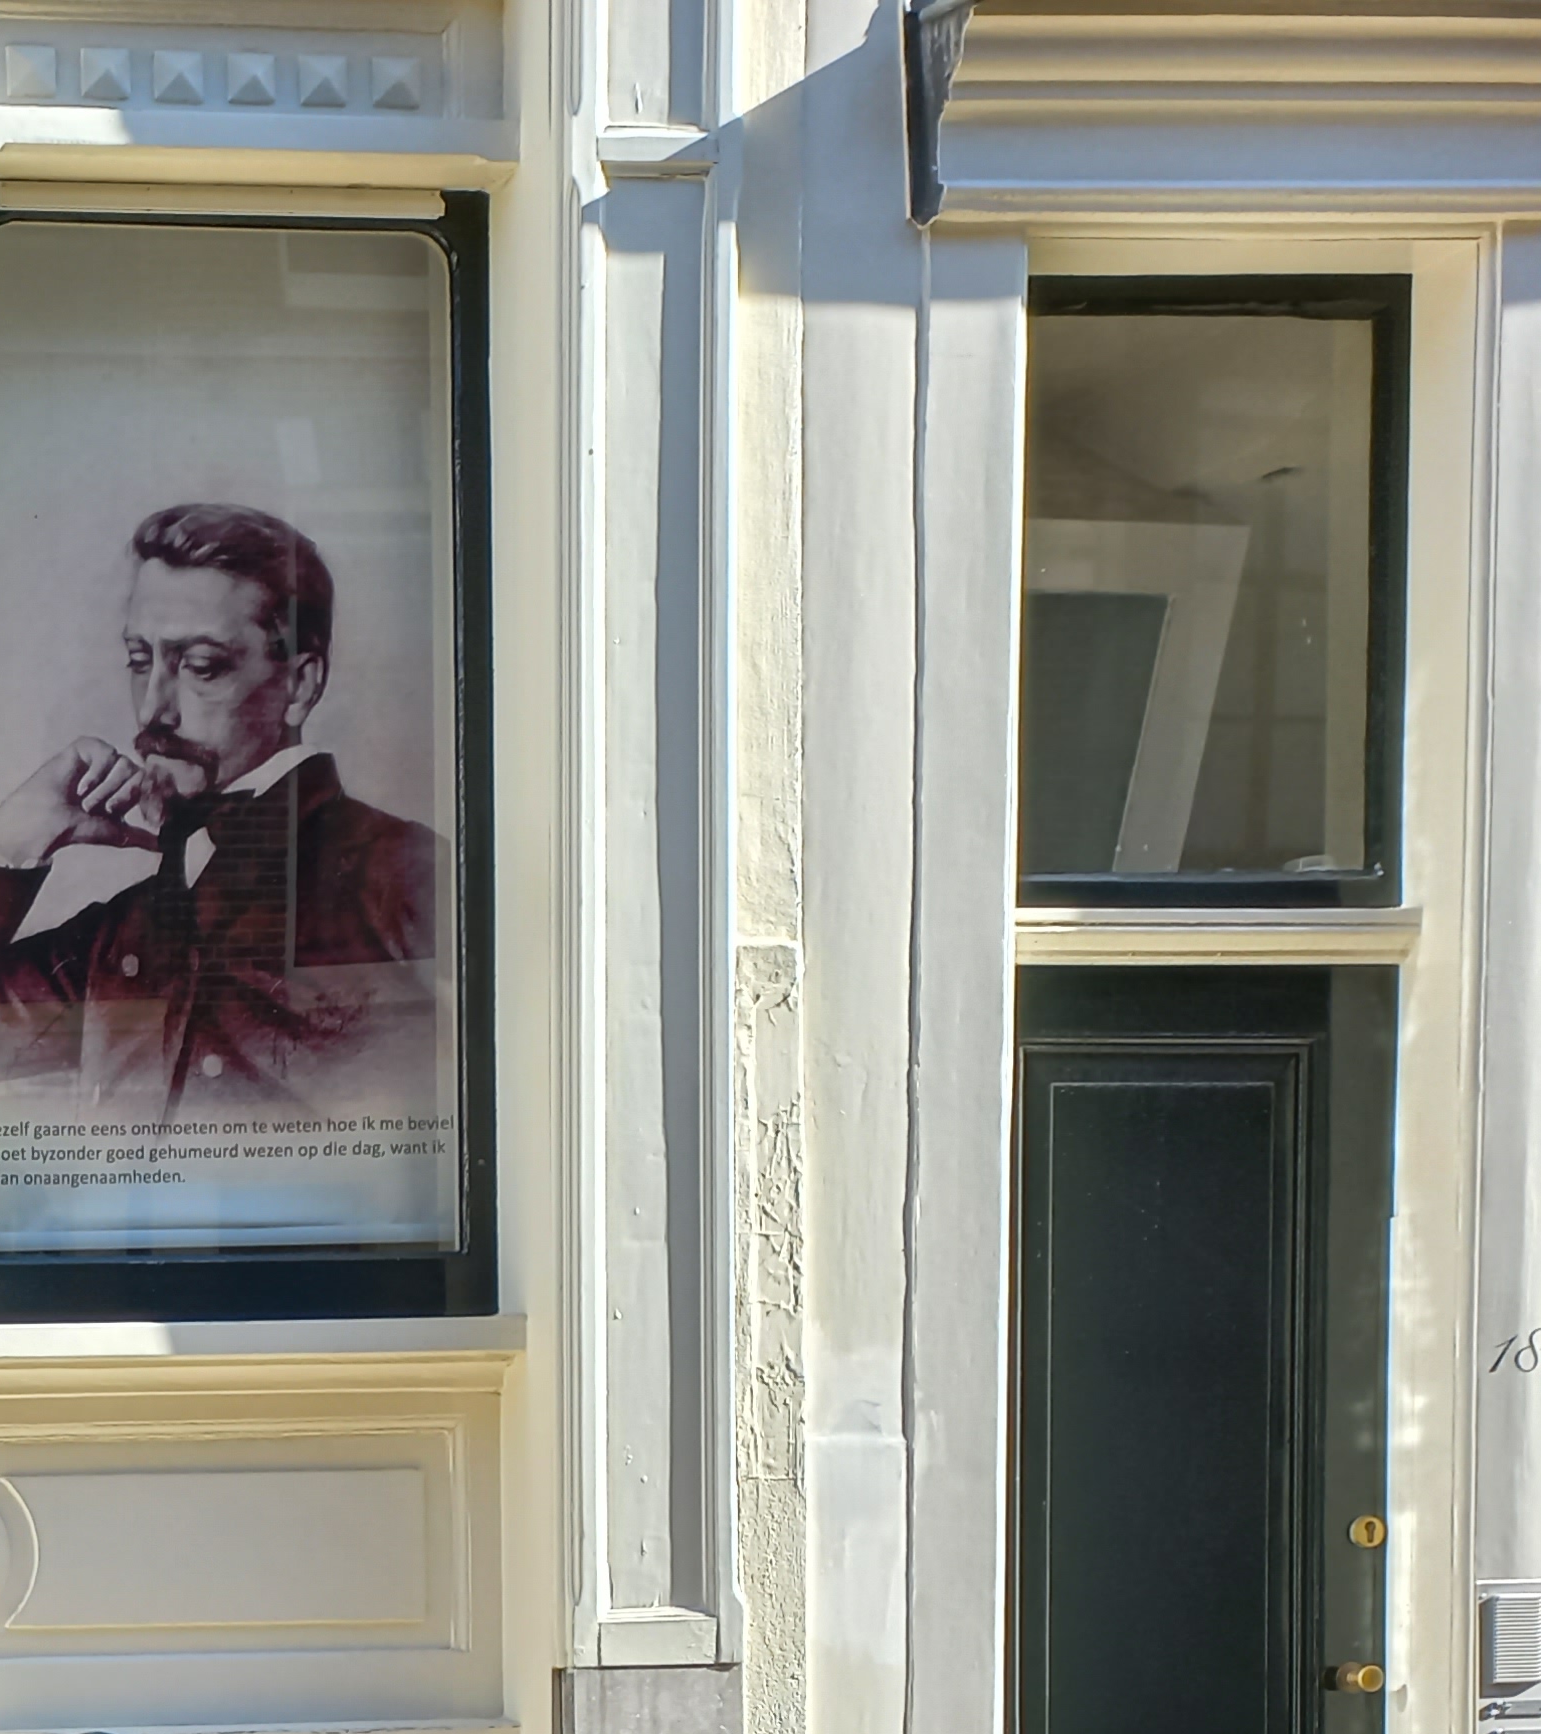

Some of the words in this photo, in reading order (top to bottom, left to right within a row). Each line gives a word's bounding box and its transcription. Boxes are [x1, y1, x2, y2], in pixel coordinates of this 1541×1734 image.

[33, 1124, 86, 1140] gaarne
[91, 1123, 127, 1136] eens
[131, 1121, 218, 1136] ontmoeten
[223, 1121, 247, 1134] om
[252, 1120, 268, 1133] te
[273, 1119, 322, 1133] weten
[327, 1118, 357, 1132] hoe
[363, 1116, 375, 1130] ik
[380, 1118, 403, 1130] me
[408, 1115, 454, 1130] beviel
[31, 1146, 102, 1164] byzonder
[106, 1145, 145, 1163] goed
[149, 1143, 239, 1163] gehumeurd
[243, 1144, 293, 1157] wezen
[298, 1144, 318, 1160] op
[323, 1141, 347, 1156] die
[352, 1140, 385, 1158] dag,
[390, 1140, 428, 1155] want
[433, 1140, 446, 1154] ik
[23, 1170, 186, 1188] onaangenaamheden.
[1489, 1327, 1541, 1373] 18
